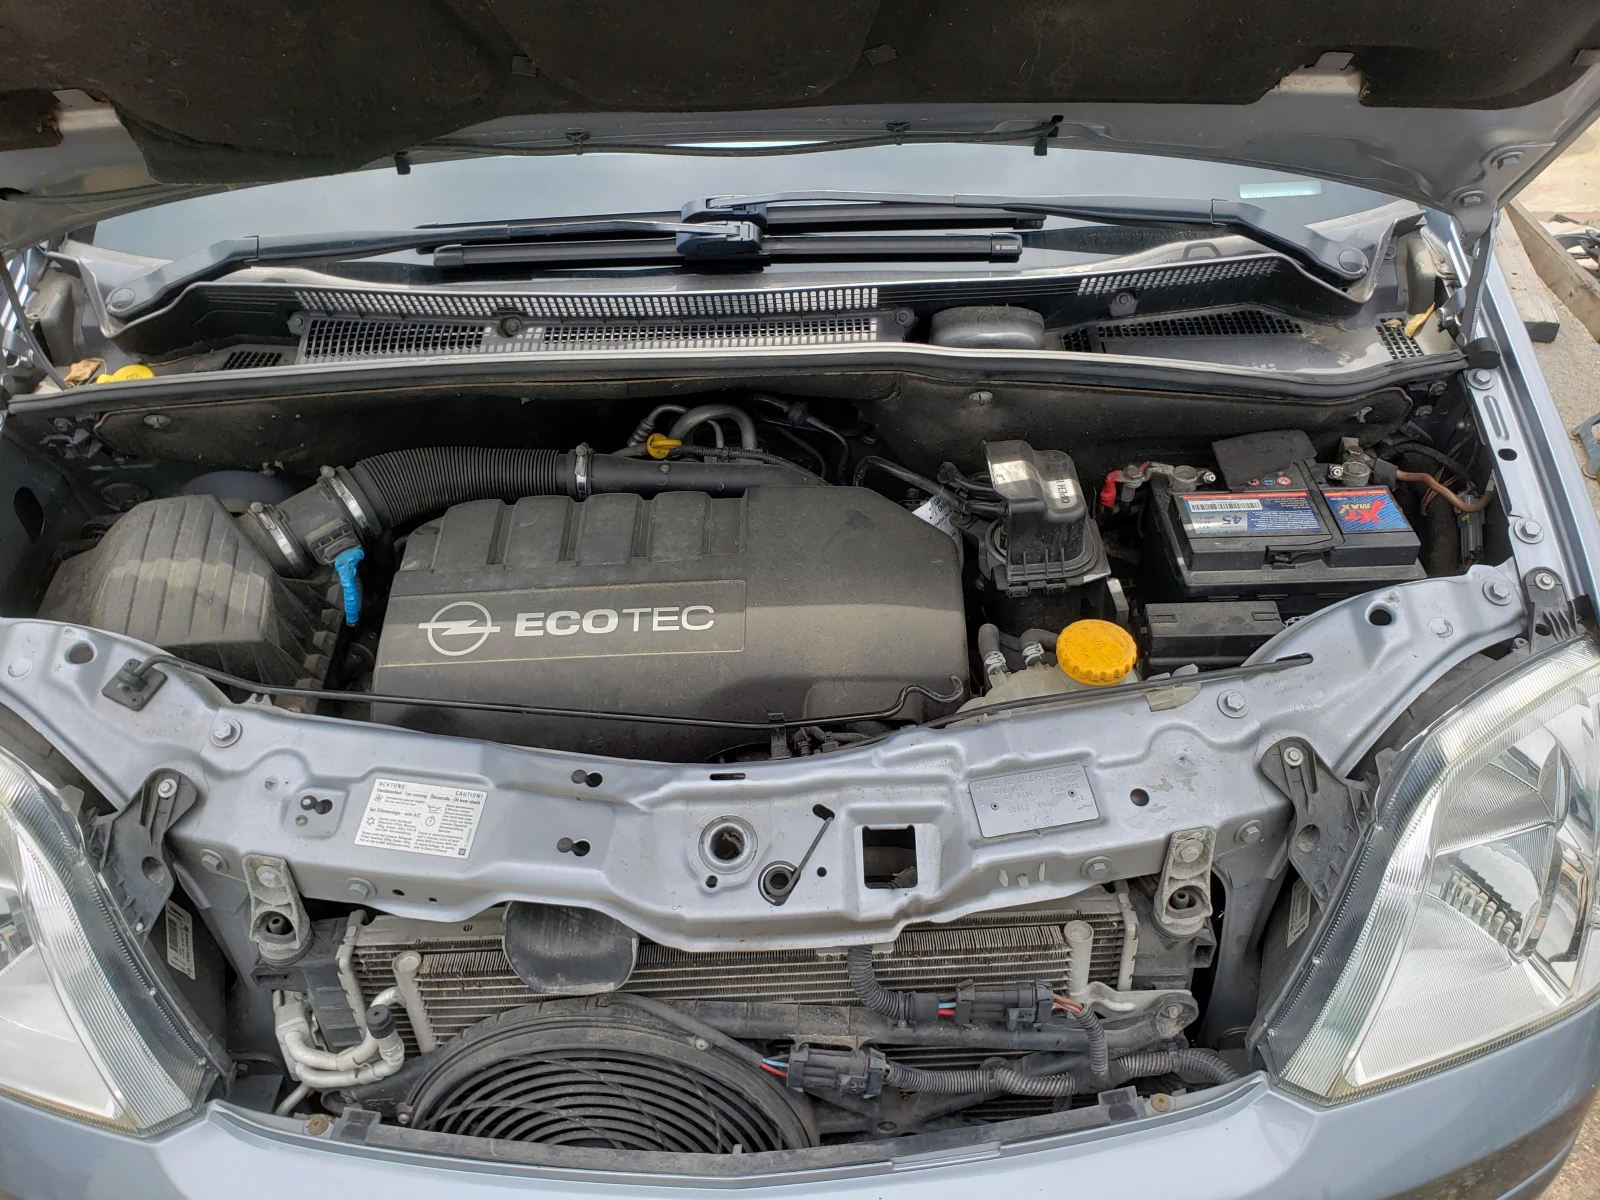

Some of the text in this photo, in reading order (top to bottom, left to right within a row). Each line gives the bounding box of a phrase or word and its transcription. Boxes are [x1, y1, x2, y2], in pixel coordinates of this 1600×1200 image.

[1057, 484, 1070, 504] OPEN
[1339, 503, 1371, 514] MAX
[1222, 514, 1243, 525] 45
[514, 605, 715, 638] ECOTEC
[379, 781, 408, 790] ACHTUNG!
[455, 790, 484, 799] CAUTION!
